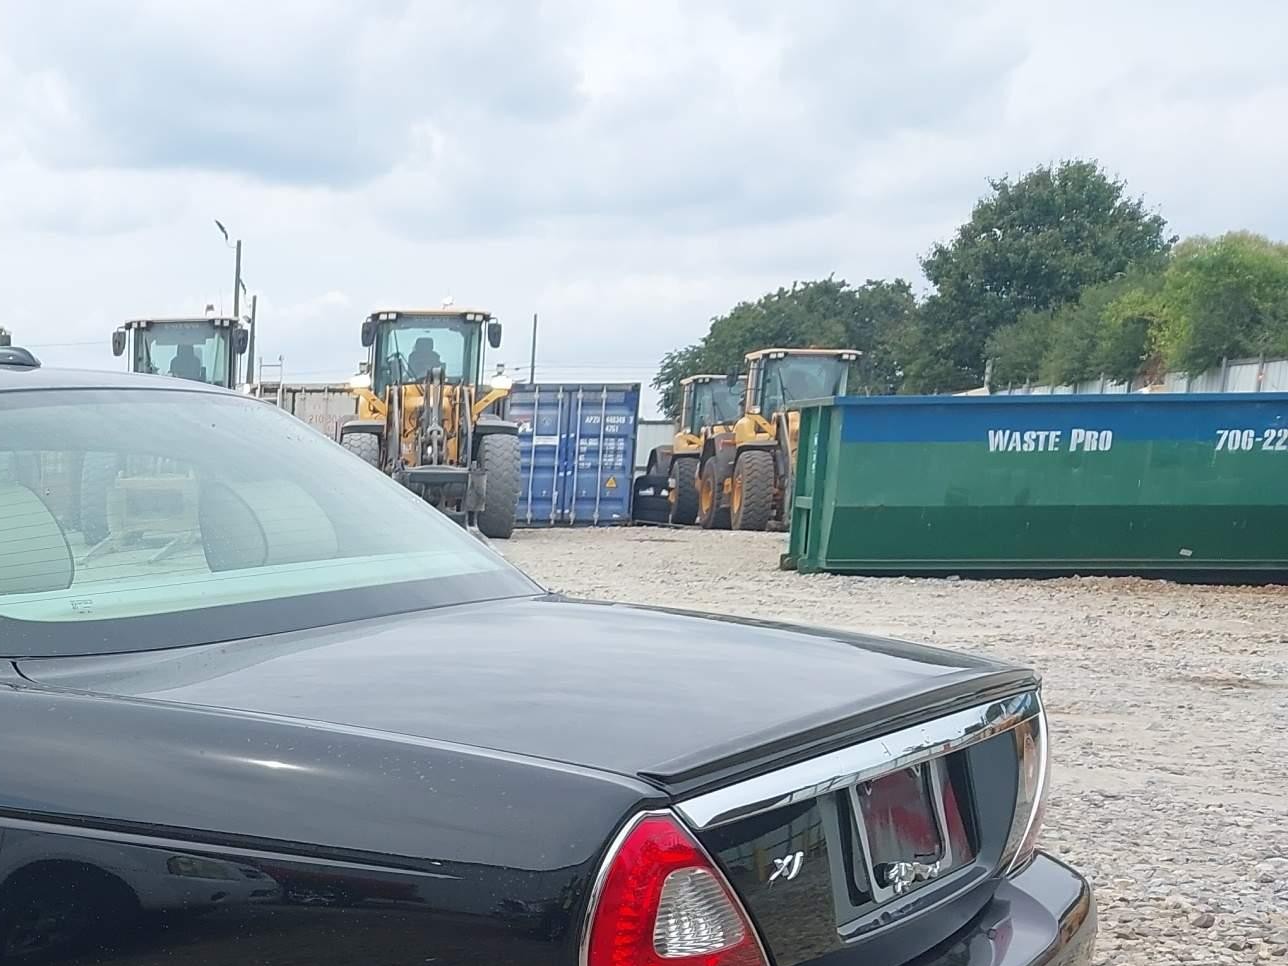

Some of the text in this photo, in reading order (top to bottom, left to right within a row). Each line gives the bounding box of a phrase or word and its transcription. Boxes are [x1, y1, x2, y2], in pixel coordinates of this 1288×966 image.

[988, 428, 1113, 452] WASTE PRO
[1215, 429, 1288, 451] 706-22
